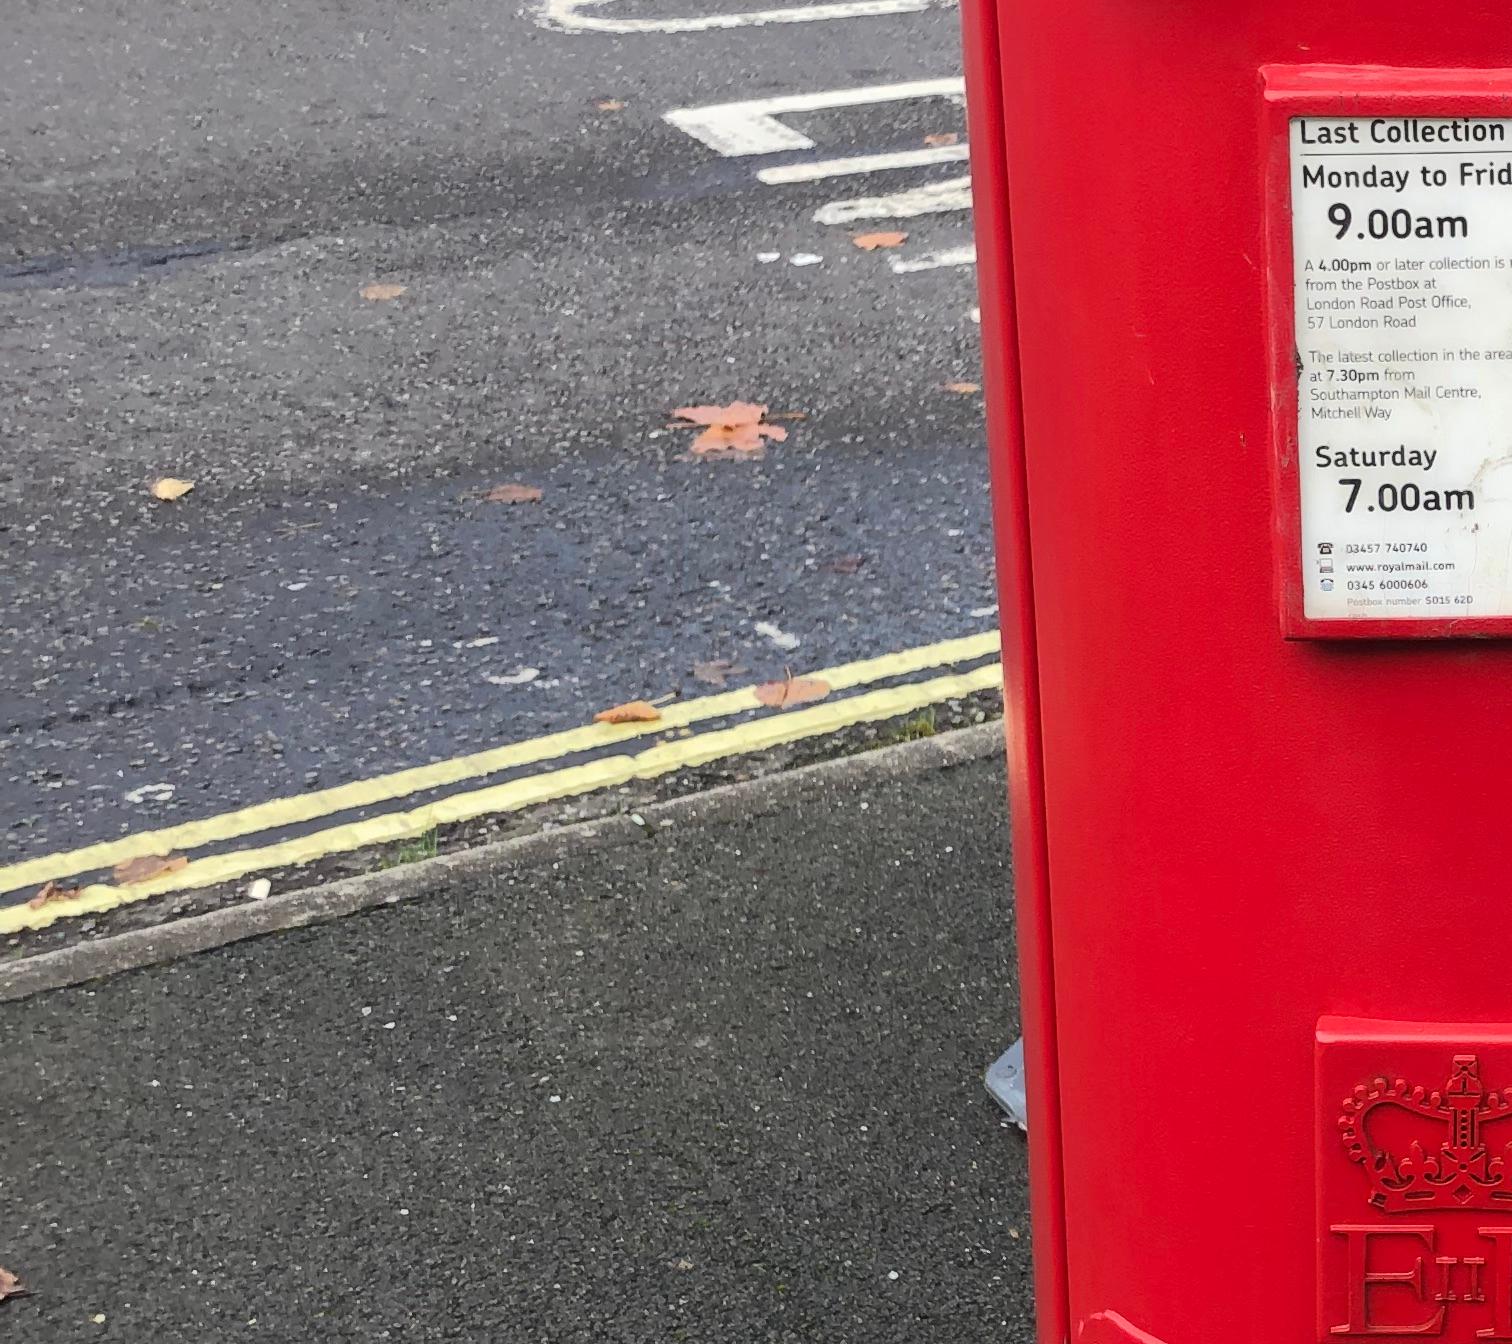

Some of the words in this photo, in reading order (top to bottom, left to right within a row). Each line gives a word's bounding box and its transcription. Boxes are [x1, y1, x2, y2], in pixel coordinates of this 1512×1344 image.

[1300, 120, 1359, 144] Last
[1370, 118, 1504, 142] Collection
[1302, 164, 1409, 192] Monday
[1421, 166, 1447, 186] to
[1328, 202, 1468, 240] 9.00am
[1304, 260, 1314, 272] A
[1319, 260, 1371, 274] 4.00pm
[1377, 260, 1391, 270] or
[1395, 258, 1425, 270] later
[1429, 256, 1490, 270] collection
[1495, 257, 1505, 269] is
[1305, 278, 1337, 291] from
[1341, 278, 1363, 290] the
[1368, 277, 1419, 290] Postbox
[1424, 278, 1436, 289] at
[1307, 297, 1356, 310] London
[1361, 297, 1393, 309] Road
[1399, 296, 1427, 309] Post
[1431, 295, 1472, 310] Office,
[1307, 316, 1324, 329] 57
[1329, 316, 1379, 329] London
[1384, 315, 1416, 328] Road
[1309, 350, 1334, 363] The
[1338, 350, 1374, 363] latest
[1378, 349, 1438, 362] collection
[1443, 349, 1455, 361] in
[1459, 348, 1480, 360] the
[1485, 349, 1512, 360] area
[1310, 370, 1323, 382] at
[1327, 369, 1379, 384] 7.30pm
[1384, 369, 1415, 380] from
[1310, 388, 1399, 402] Southampton
[1404, 387, 1431, 399] Mail
[1435, 387, 1481, 400] Centre,
[1311, 407, 1361, 419] Mitchell
[1365, 406, 1392, 421] Way
[1316, 446, 1437, 470] Saturday
[1338, 478, 1475, 513] 7.00am
[1346, 544, 1380, 554] 03457
[1385, 543, 1428, 553] 740740
[1347, 561, 1455, 573] www.royalmail.com
[1347, 580, 1375, 590] 0345
[1379, 580, 1428, 589] 6000606
[1347, 597, 1382, 606] Postbox
[1386, 597, 1421, 605] number
